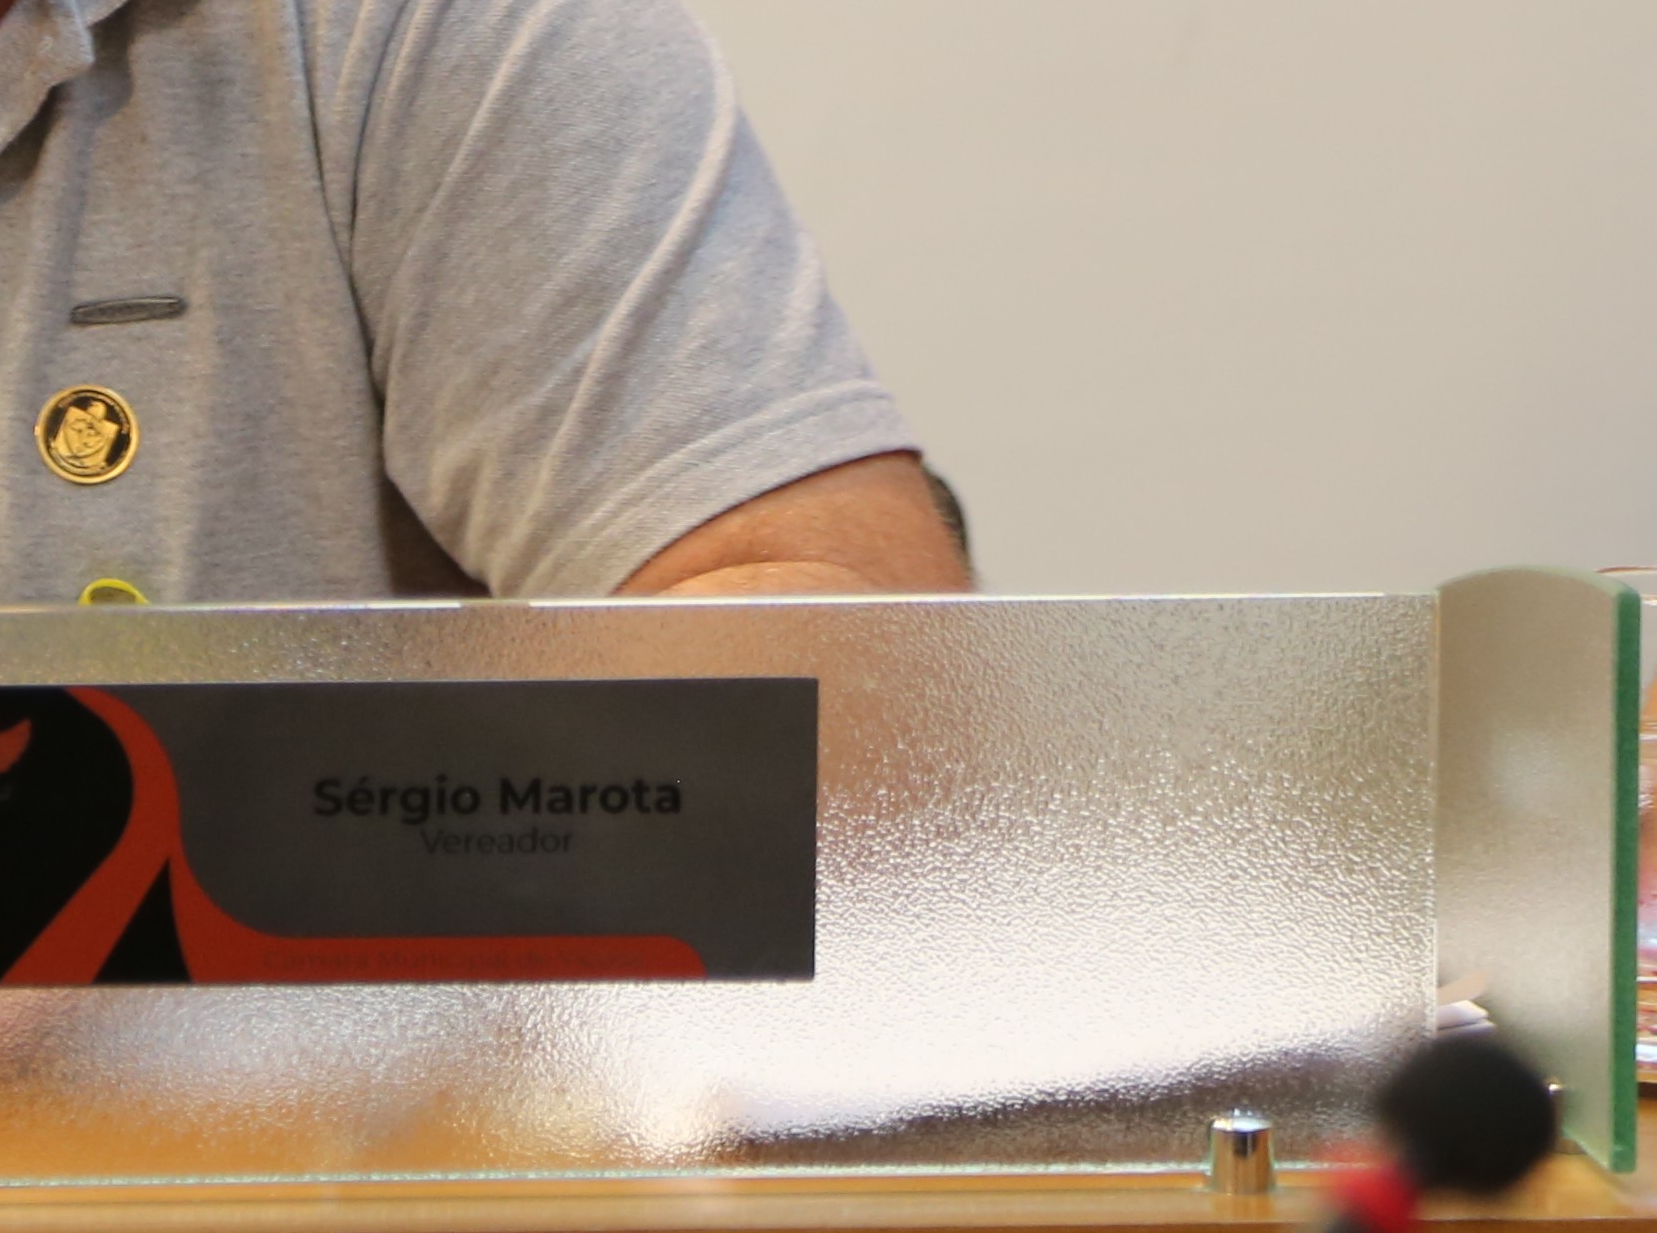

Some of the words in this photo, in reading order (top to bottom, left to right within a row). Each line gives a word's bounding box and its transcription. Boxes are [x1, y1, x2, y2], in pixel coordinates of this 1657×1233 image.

[313, 773, 481, 825] Sérgio
[499, 776, 682, 815] Marota
[419, 827, 573, 855] Vereador
